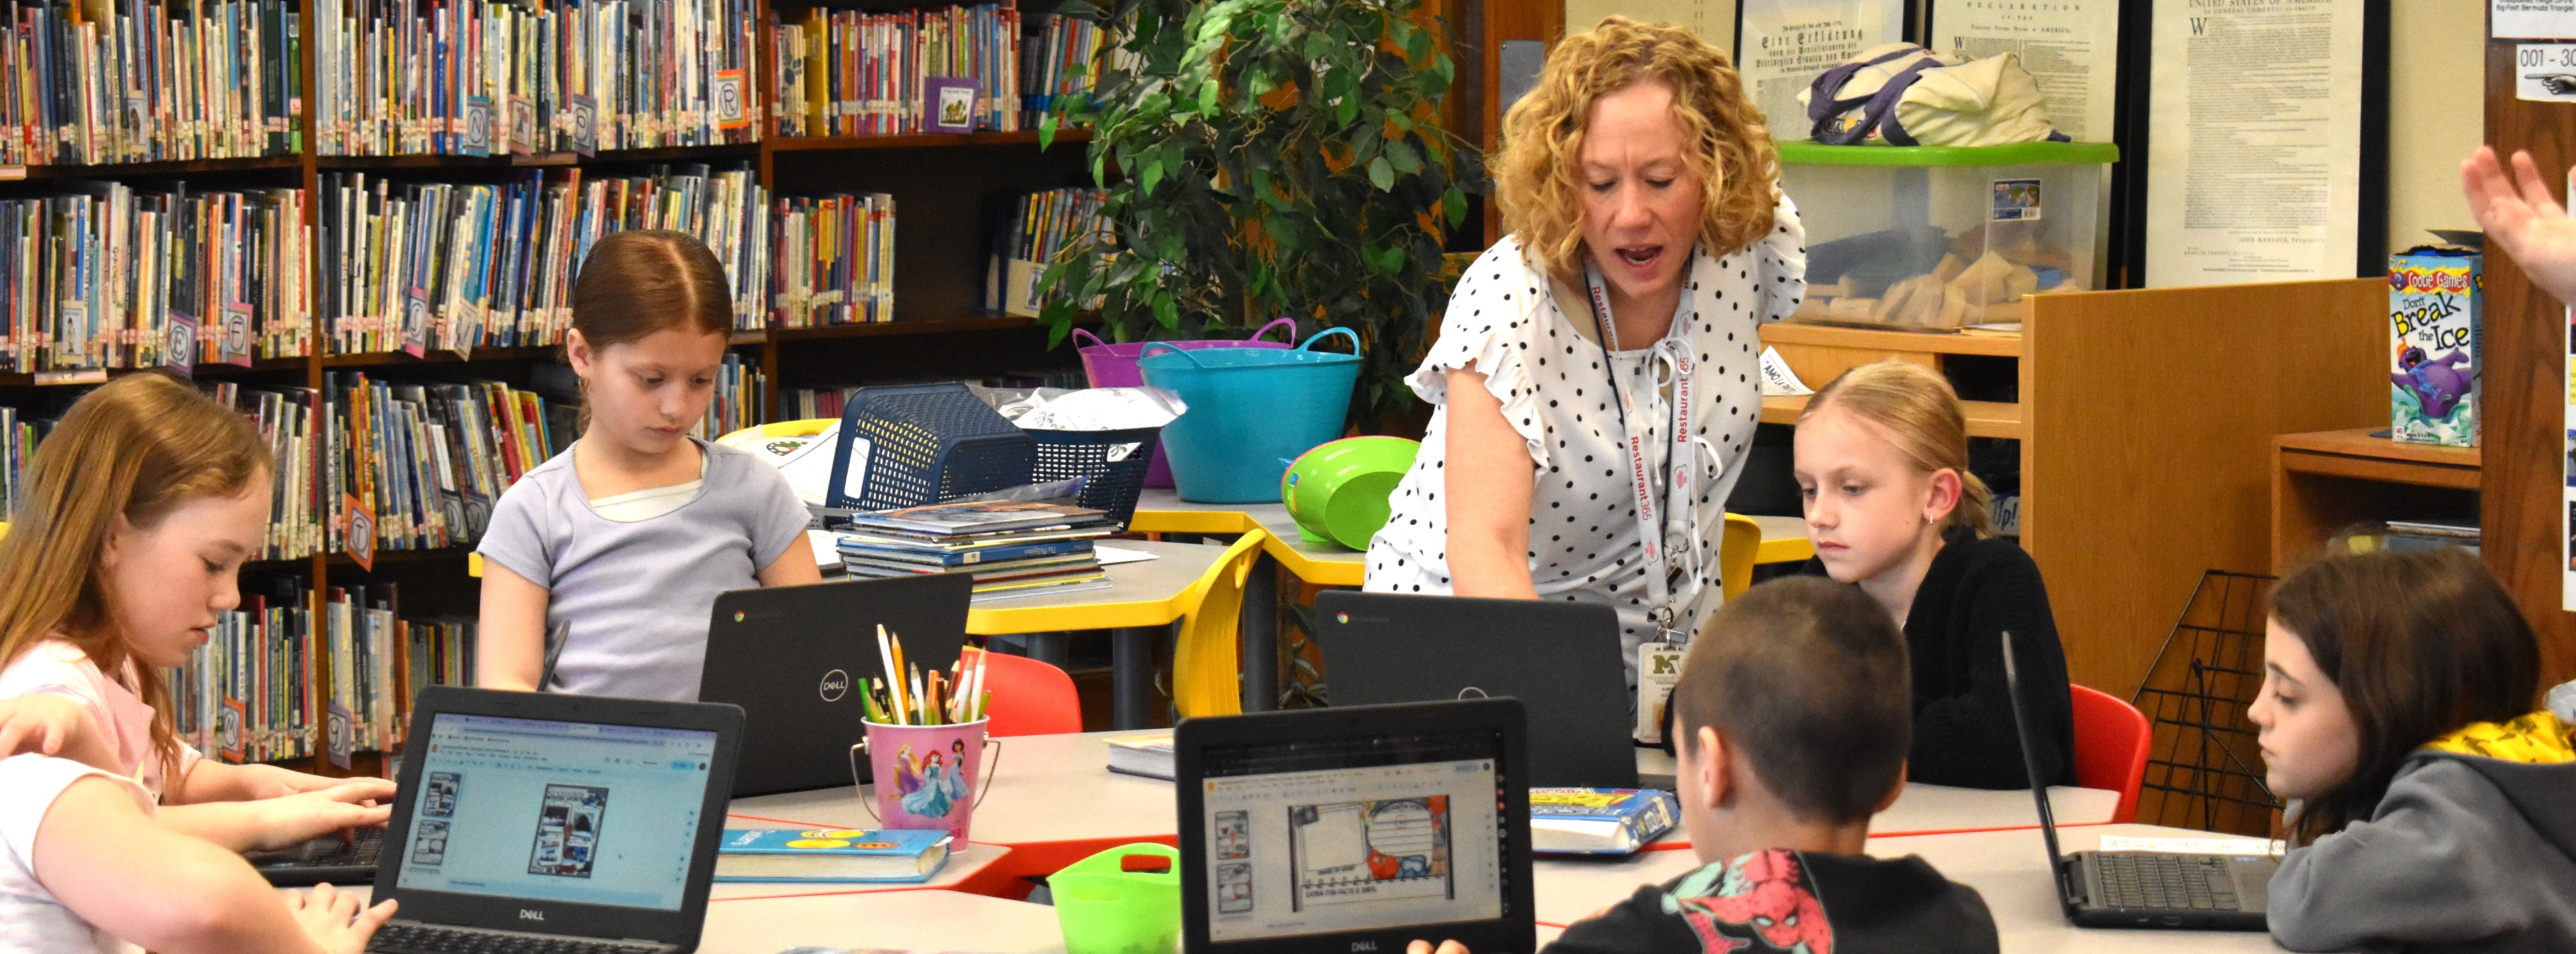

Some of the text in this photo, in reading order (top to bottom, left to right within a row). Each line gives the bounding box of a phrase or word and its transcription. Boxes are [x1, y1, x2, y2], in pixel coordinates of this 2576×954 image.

[1967, 2, 2080, 11] DECLARATION
[2520, 49, 2544, 67] 001
[724, 89, 735, 113] R
[2408, 272, 2434, 288] Cootie
[2436, 271, 2467, 288] Games
[2391, 291, 2461, 339] Break
[231, 321, 241, 348] F
[2418, 330, 2433, 341] the
[2430, 325, 2470, 351] Ice
[823, 681, 844, 690] DELL
[519, 909, 544, 921] DELL
[1351, 940, 1379, 952] DELL
